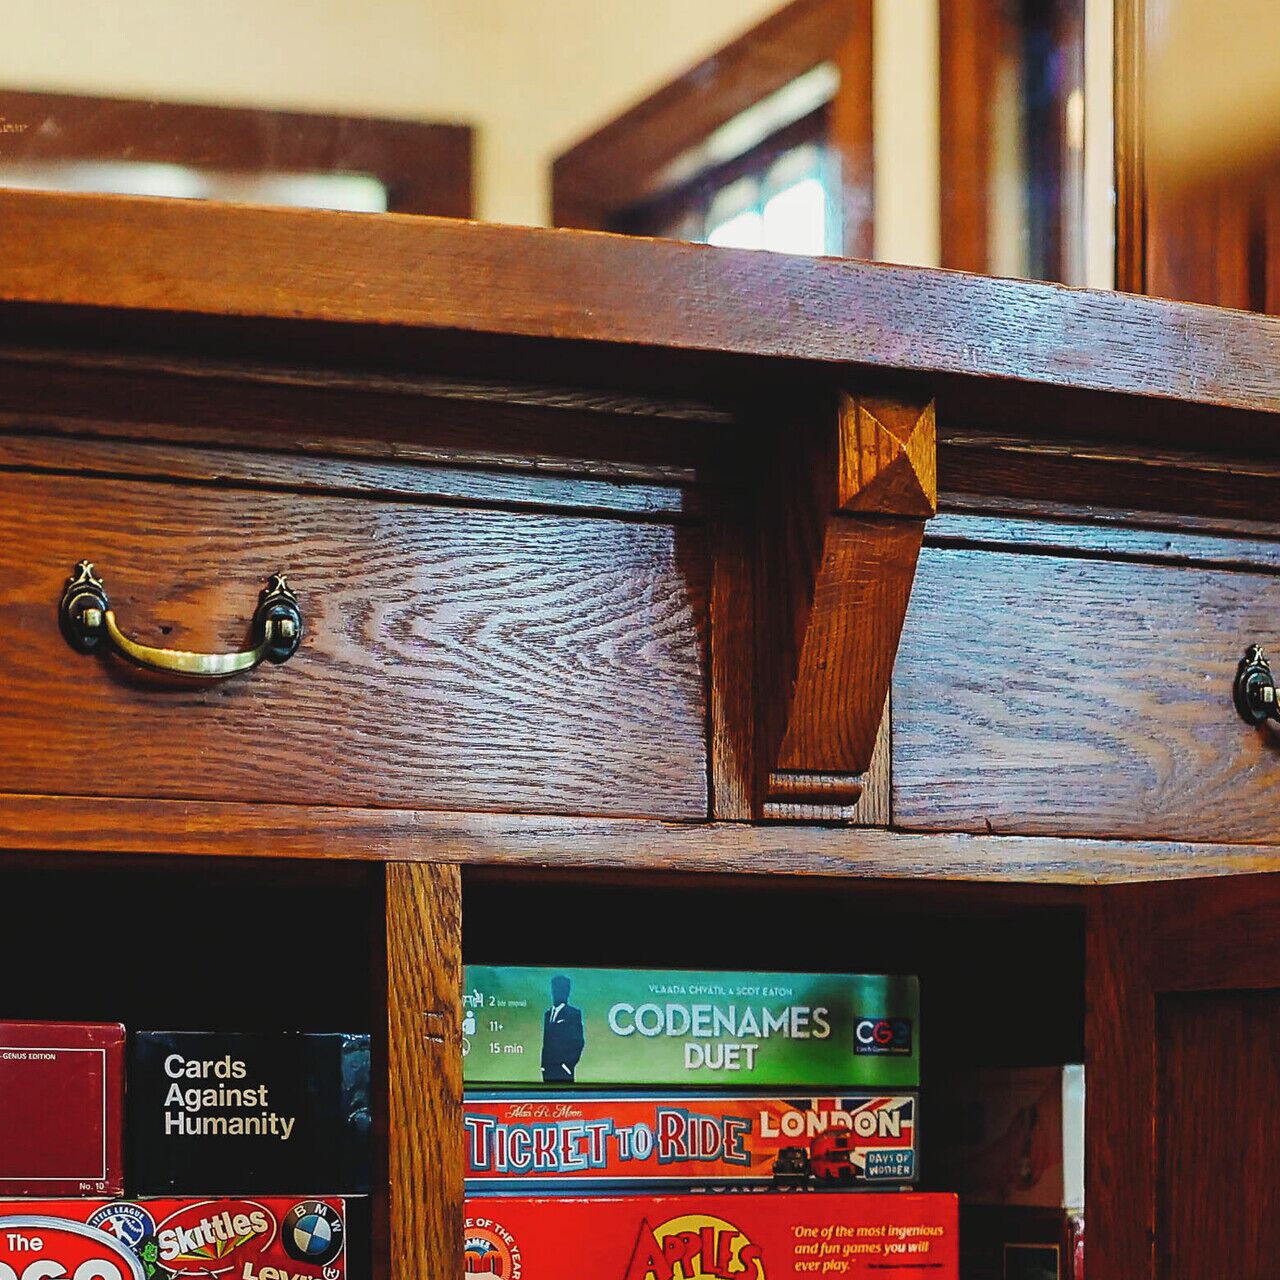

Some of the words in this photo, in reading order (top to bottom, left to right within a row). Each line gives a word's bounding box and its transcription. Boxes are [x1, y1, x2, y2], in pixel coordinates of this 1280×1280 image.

[736, 986, 759, 996] SCOT
[762, 987, 793, 997] EATON
[489, 996, 496, 1007] 2
[490, 1021, 504, 1032] 11+
[608, 1003, 832, 1040] CODENAMES
[489, 1042, 501, 1054] 15
[504, 1042, 523, 1053] min
[683, 1042, 759, 1071] DUET
[164, 1054, 247, 1079] Cards
[164, 1083, 269, 1112] Against
[164, 1112, 295, 1140] Humanity
[760, 1109, 901, 1138] LONDON
[465, 1117, 609, 1168] TICKET
[616, 1130, 650, 1157] TO
[658, 1111, 750, 1160] RIDE
[896, 1153, 908, 1163] OF
[79, 1182, 94, 1191] No.
[114, 1206, 145, 1220] LEAGUE
[294, 1203, 342, 1233] BMW
[158, 1210, 268, 1259] Skittles
[821, 1225, 834, 1240] of
[836, 1225, 854, 1238] the
[856, 1225, 886, 1238] most
[888, 1224, 944, 1240] ingenious
[7, 1234, 43, 1251] The
[466, 1238, 491, 1249] AMES
[476, 1218, 493, 1228] OF
[494, 1223, 515, 1245] THE
[510, 1245, 521, 1280] YEAR
[795, 1242, 819, 1254] and
[819, 1242, 840, 1257] fun
[842, 1243, 881, 1257] games
[884, 1243, 906, 1257] you
[908, 1241, 930, 1253] will
[795, 1260, 820, 1271] ever
